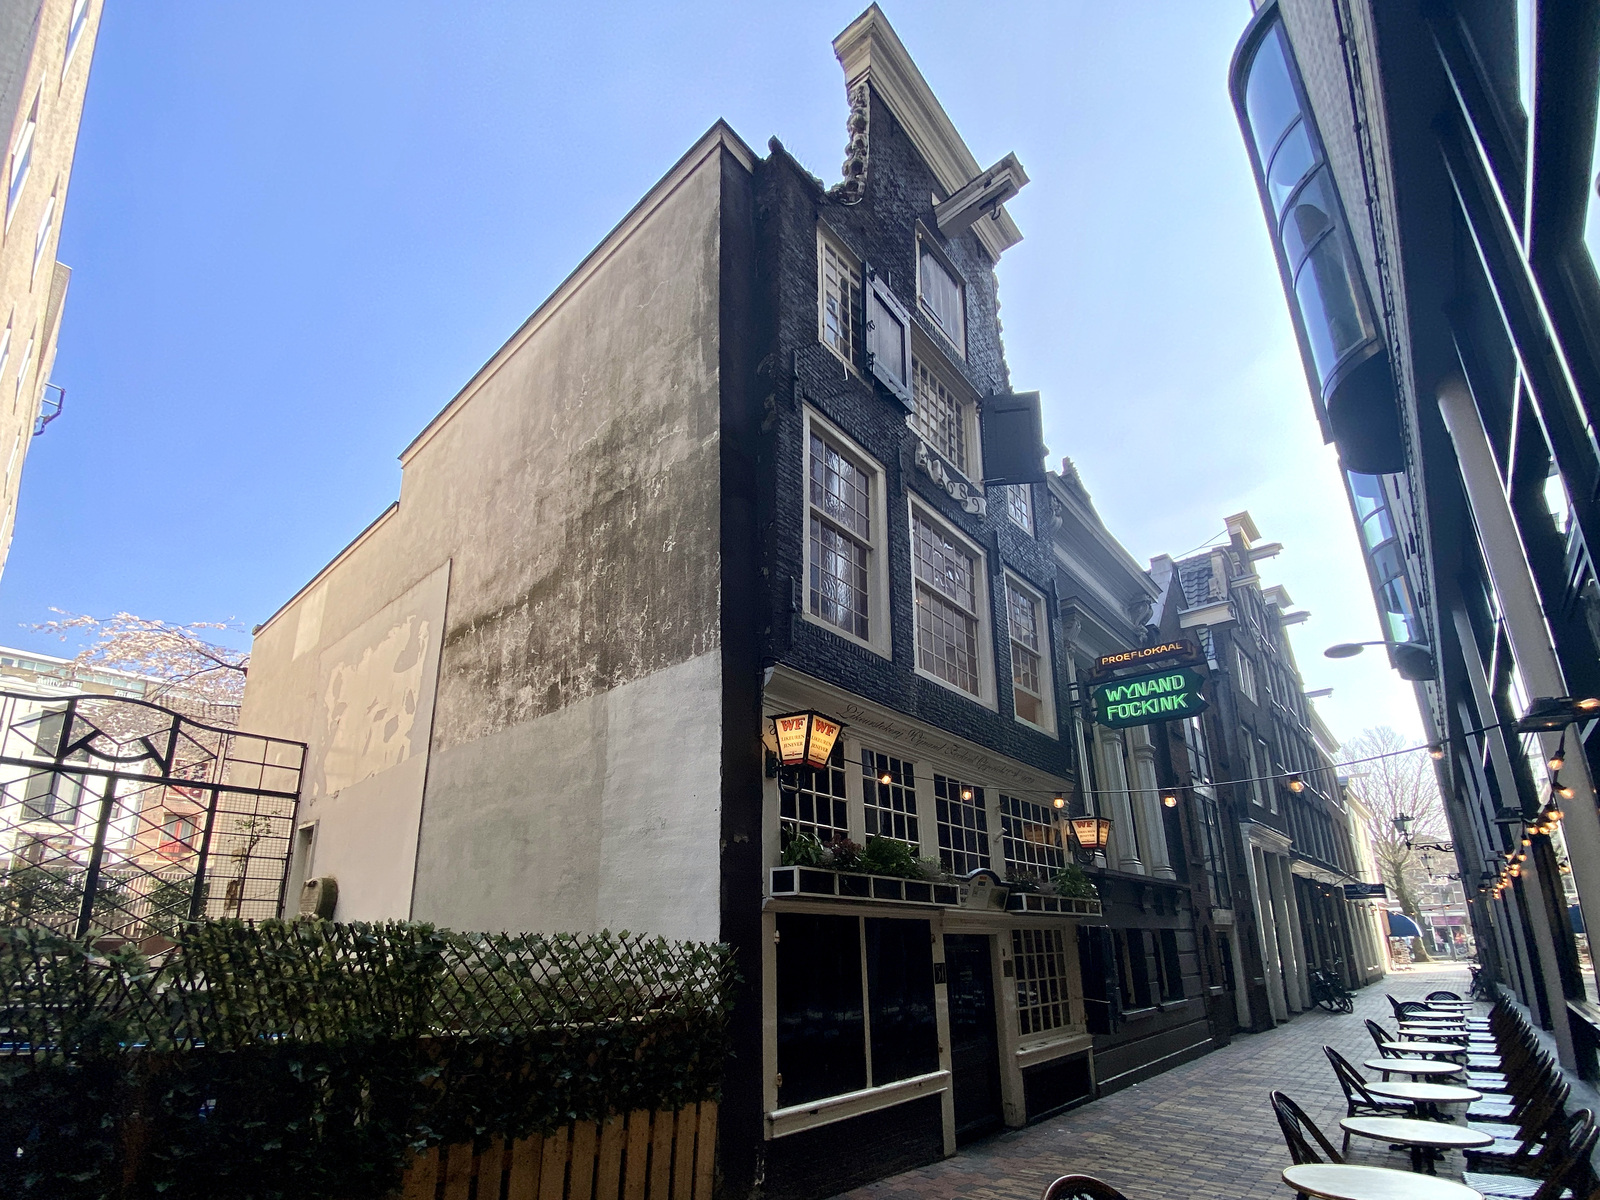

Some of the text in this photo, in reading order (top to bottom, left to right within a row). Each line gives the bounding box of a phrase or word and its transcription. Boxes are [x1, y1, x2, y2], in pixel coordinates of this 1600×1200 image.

[1101, 642, 1183, 665] PROEFLOKAAL
[1105, 675, 1186, 702] WYNAND
[1107, 692, 1189, 721] FOCKINK
[780, 717, 806, 732] WF
[815, 718, 837, 737] WF
[781, 734, 805, 742] LIKEUREN
[783, 741, 803, 749] JENEVER
[811, 743, 829, 753] JENEVER
